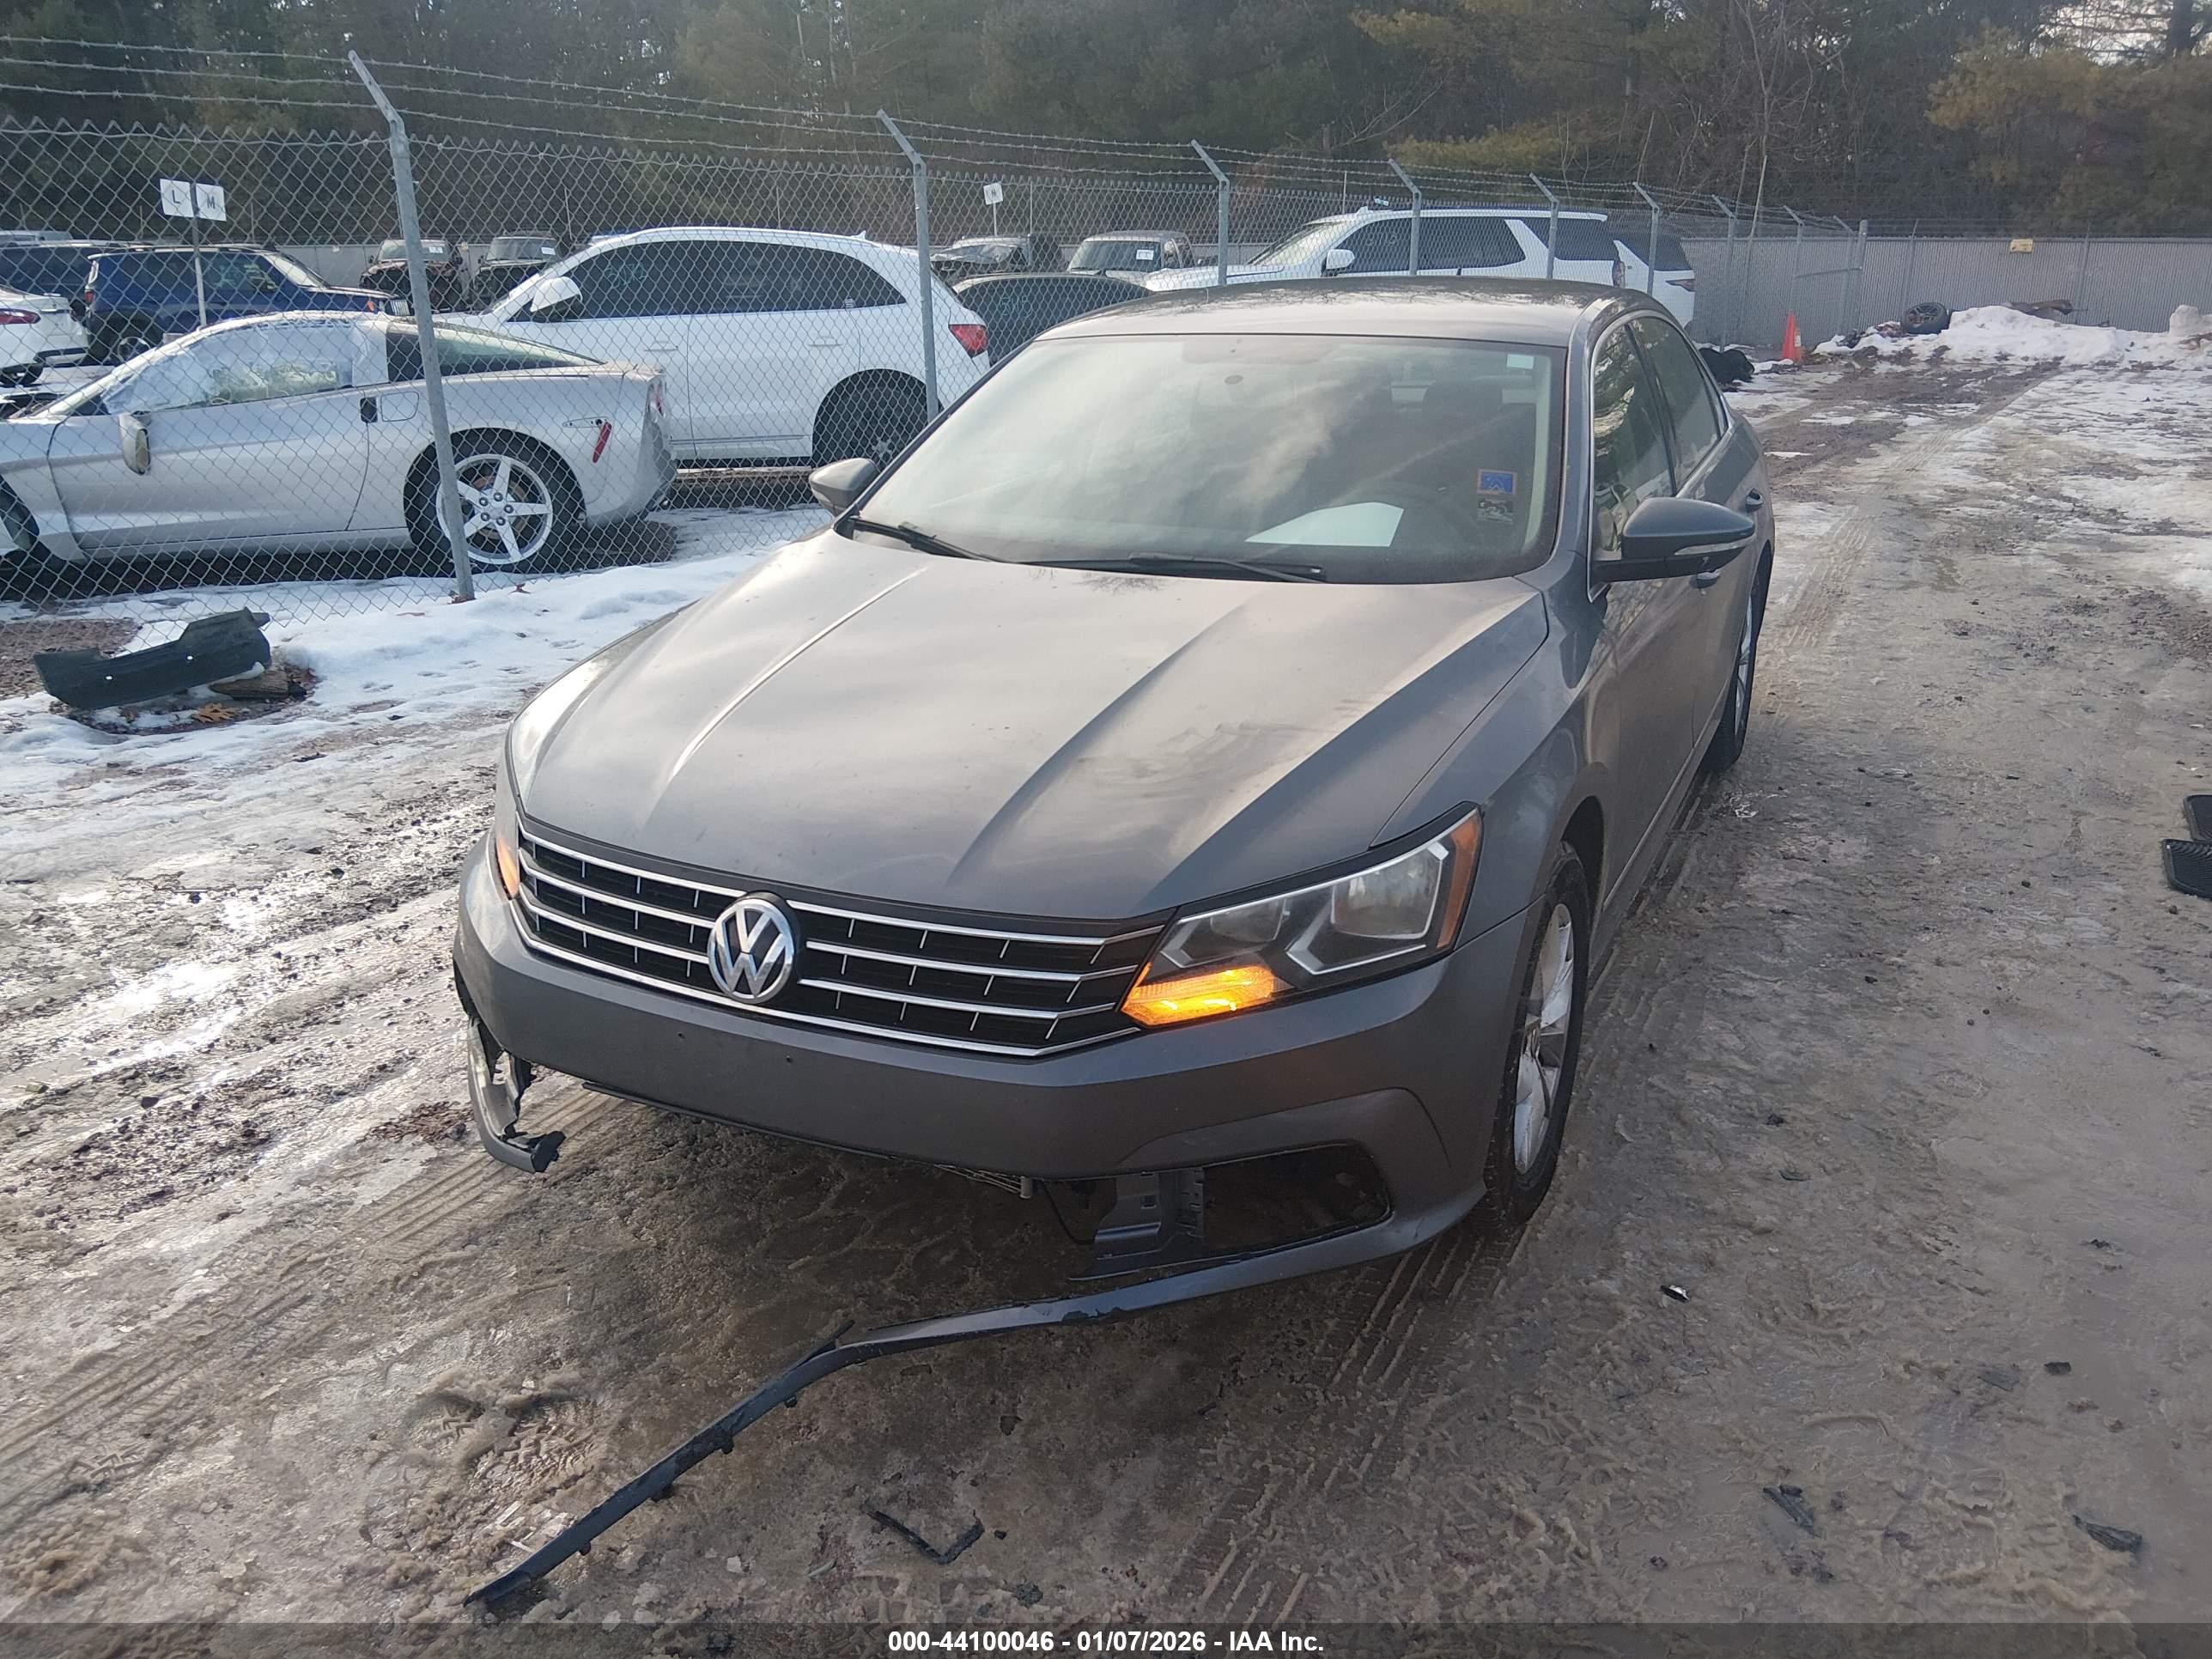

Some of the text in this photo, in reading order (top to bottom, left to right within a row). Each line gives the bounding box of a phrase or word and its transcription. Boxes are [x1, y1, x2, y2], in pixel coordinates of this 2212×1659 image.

[172, 190, 181, 204] L
[206, 195, 216, 210] M
[709, 899, 793, 1001] VW
